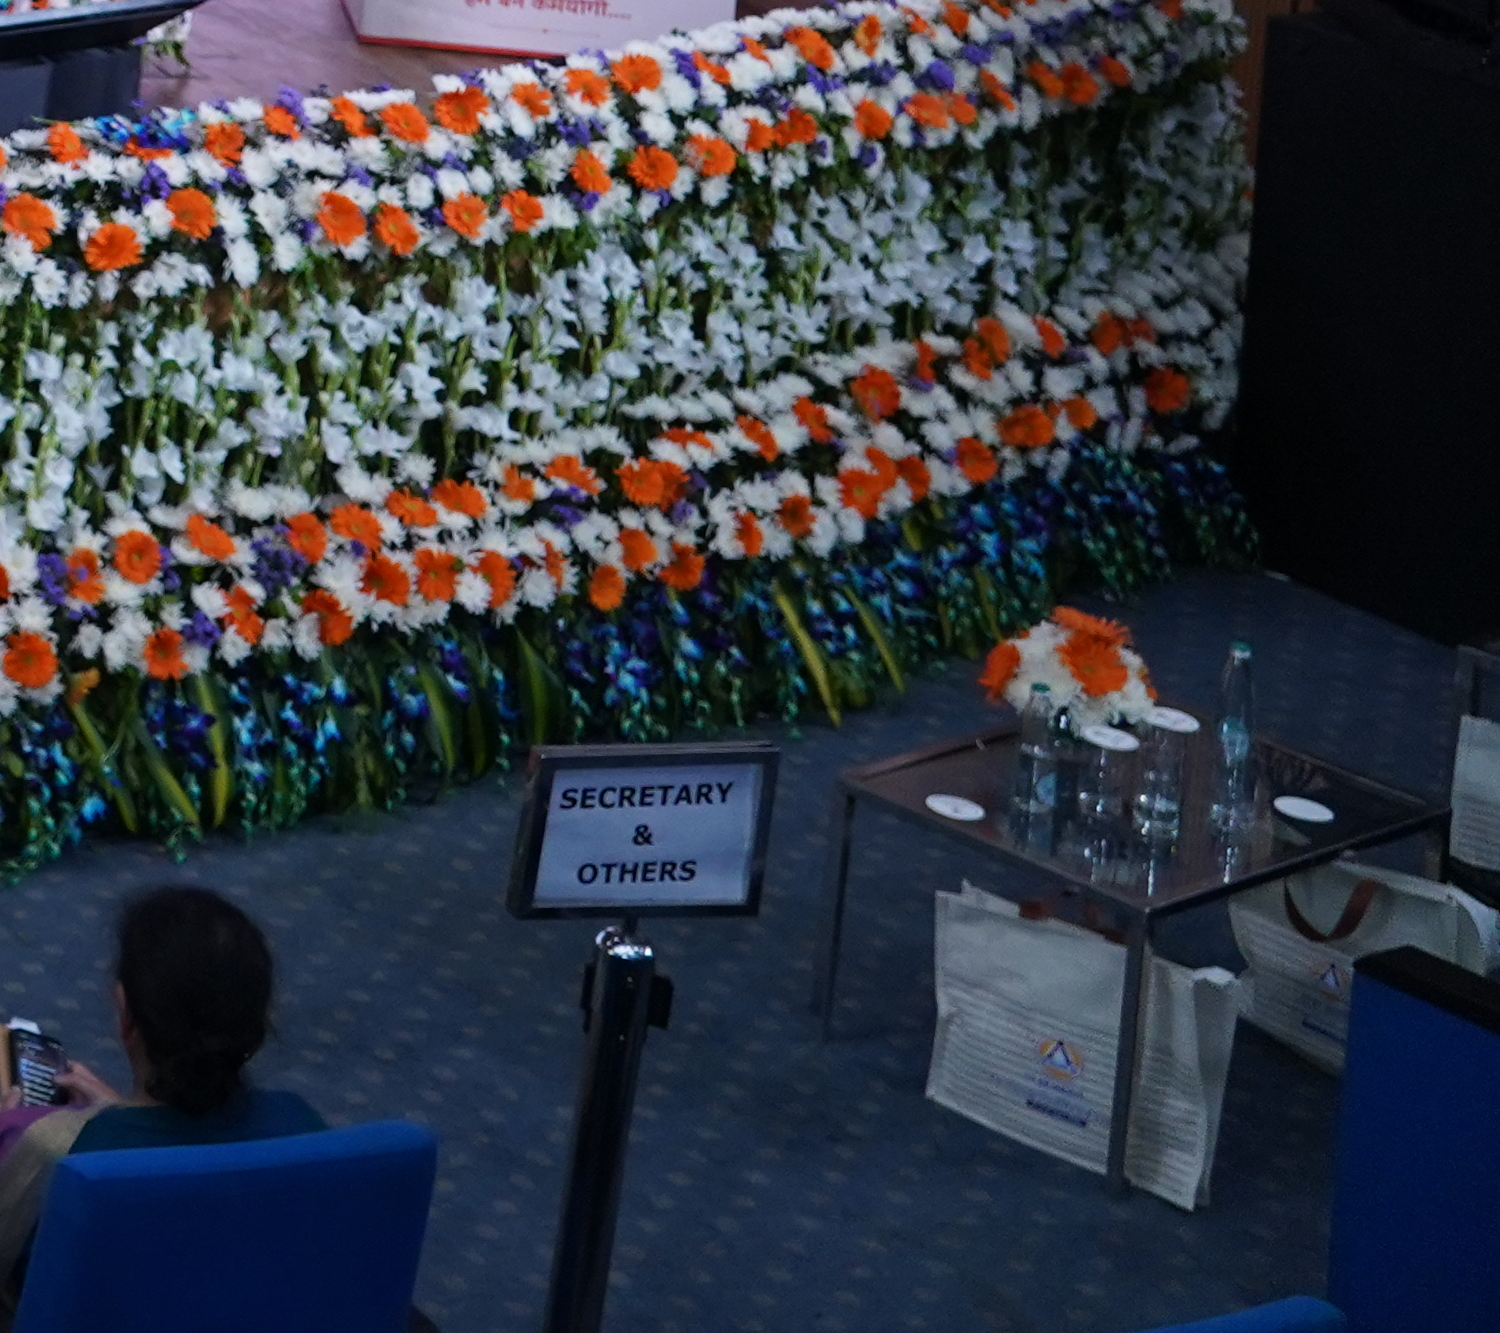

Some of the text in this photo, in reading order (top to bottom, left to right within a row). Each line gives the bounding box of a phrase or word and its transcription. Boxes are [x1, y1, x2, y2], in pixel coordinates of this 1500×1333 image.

[558, 781, 735, 811] SECRETARY
[630, 823, 655, 847] &
[576, 859, 698, 885] OTHERS
